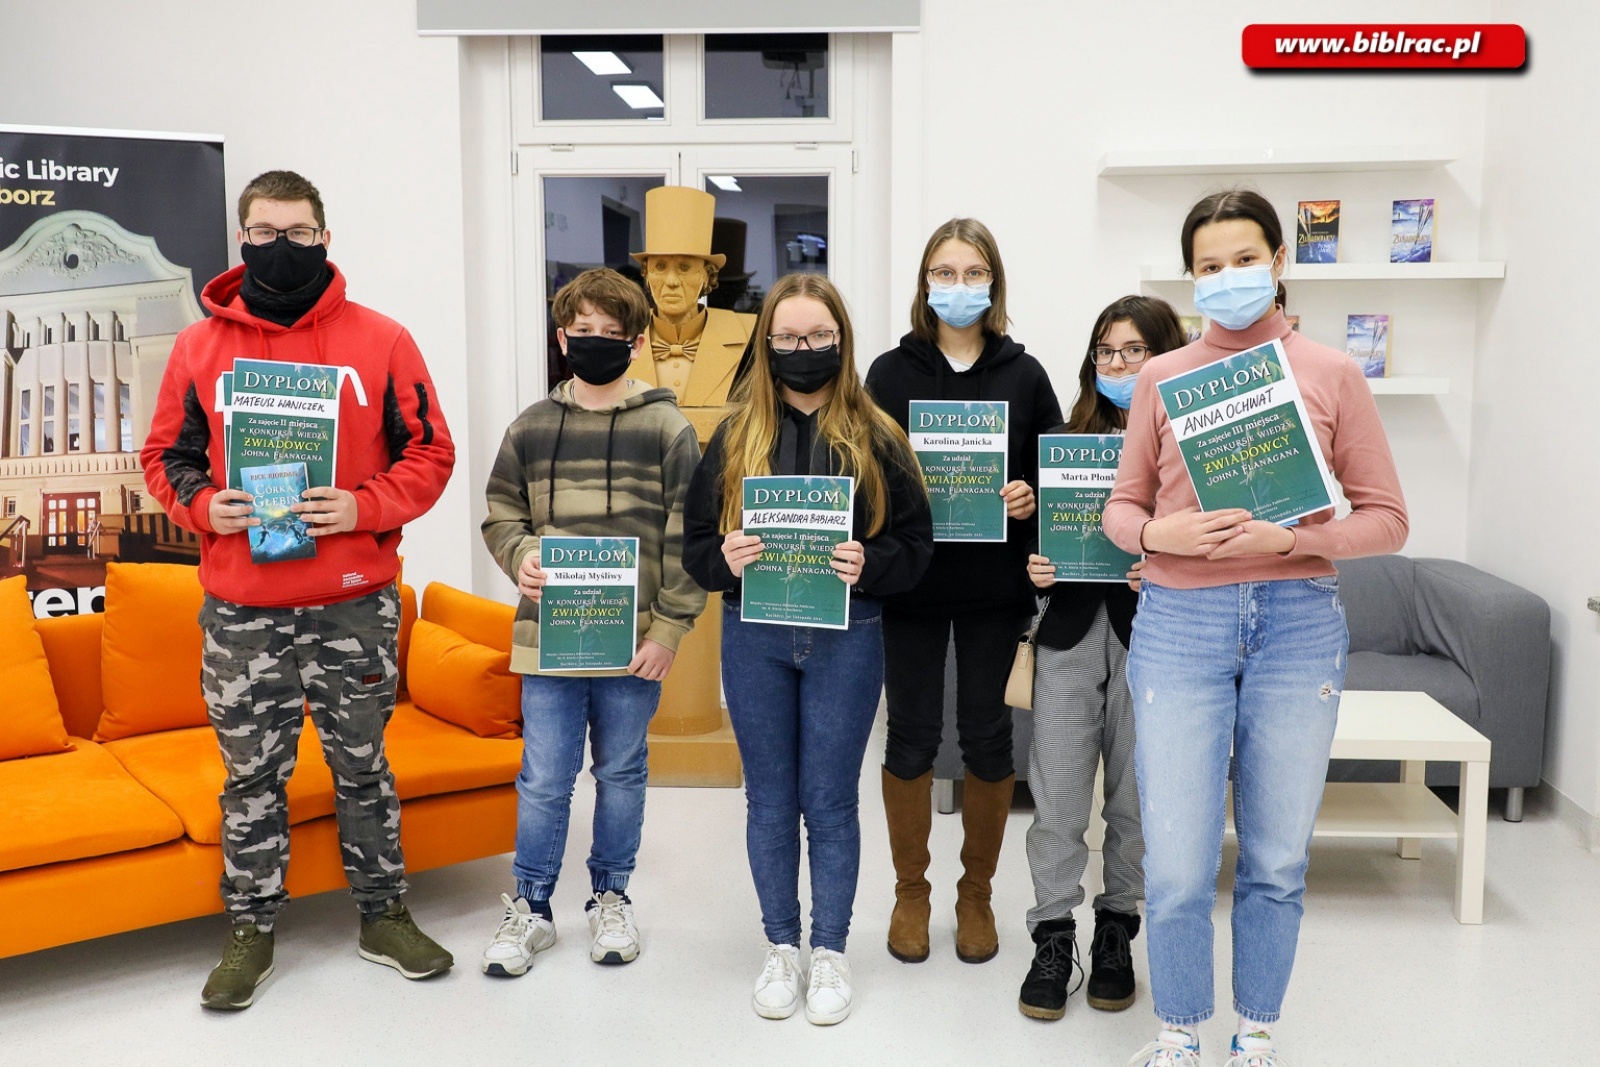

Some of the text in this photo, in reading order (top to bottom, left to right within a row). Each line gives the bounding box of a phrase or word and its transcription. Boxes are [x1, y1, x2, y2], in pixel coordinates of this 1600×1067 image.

[26, 158, 119, 188] Library
[244, 371, 328, 393] DYPLOM
[1173, 361, 1273, 411] DYPLOM
[234, 395, 325, 412] MATEUSZ WANICZEK
[1183, 387, 1274, 436] ANNA OCHWAT
[288, 420, 318, 429] miejsca
[919, 412, 997, 428] DYPLOM
[1197, 413, 1280, 448] Za zajęcie III miejsca
[923, 437, 992, 447] Karolina Janicka
[1204, 436, 1254, 459] KONKURSIE
[241, 449, 323, 462] JOHNA FLANAGANA
[952, 454, 971, 462] udział
[1206, 447, 1300, 487] JOHNA FLANAGANA
[250, 473, 266, 481] RICK
[1061, 472, 1116, 481] Marta Płonk
[255, 484, 295, 495] CÓRKA
[949, 486, 995, 495] FLANAGANA
[754, 488, 840, 505] DYPLOM
[1056, 502, 1100, 511] KONKURSIE
[749, 511, 846, 526] ALEKSANDRA BABIARZ
[1050, 524, 1078, 532] JOHNA
[771, 532, 792, 541] zajęcie
[799, 532, 829, 543] miejsca
[809, 544, 835, 552] WIEDZ
[550, 547, 627, 563] DYPLOM
[754, 564, 837, 575] JOHNA FLANAGANA
[554, 571, 622, 581] Mikołaj Myśliwy
[579, 618, 625, 627] FLANAGANA
